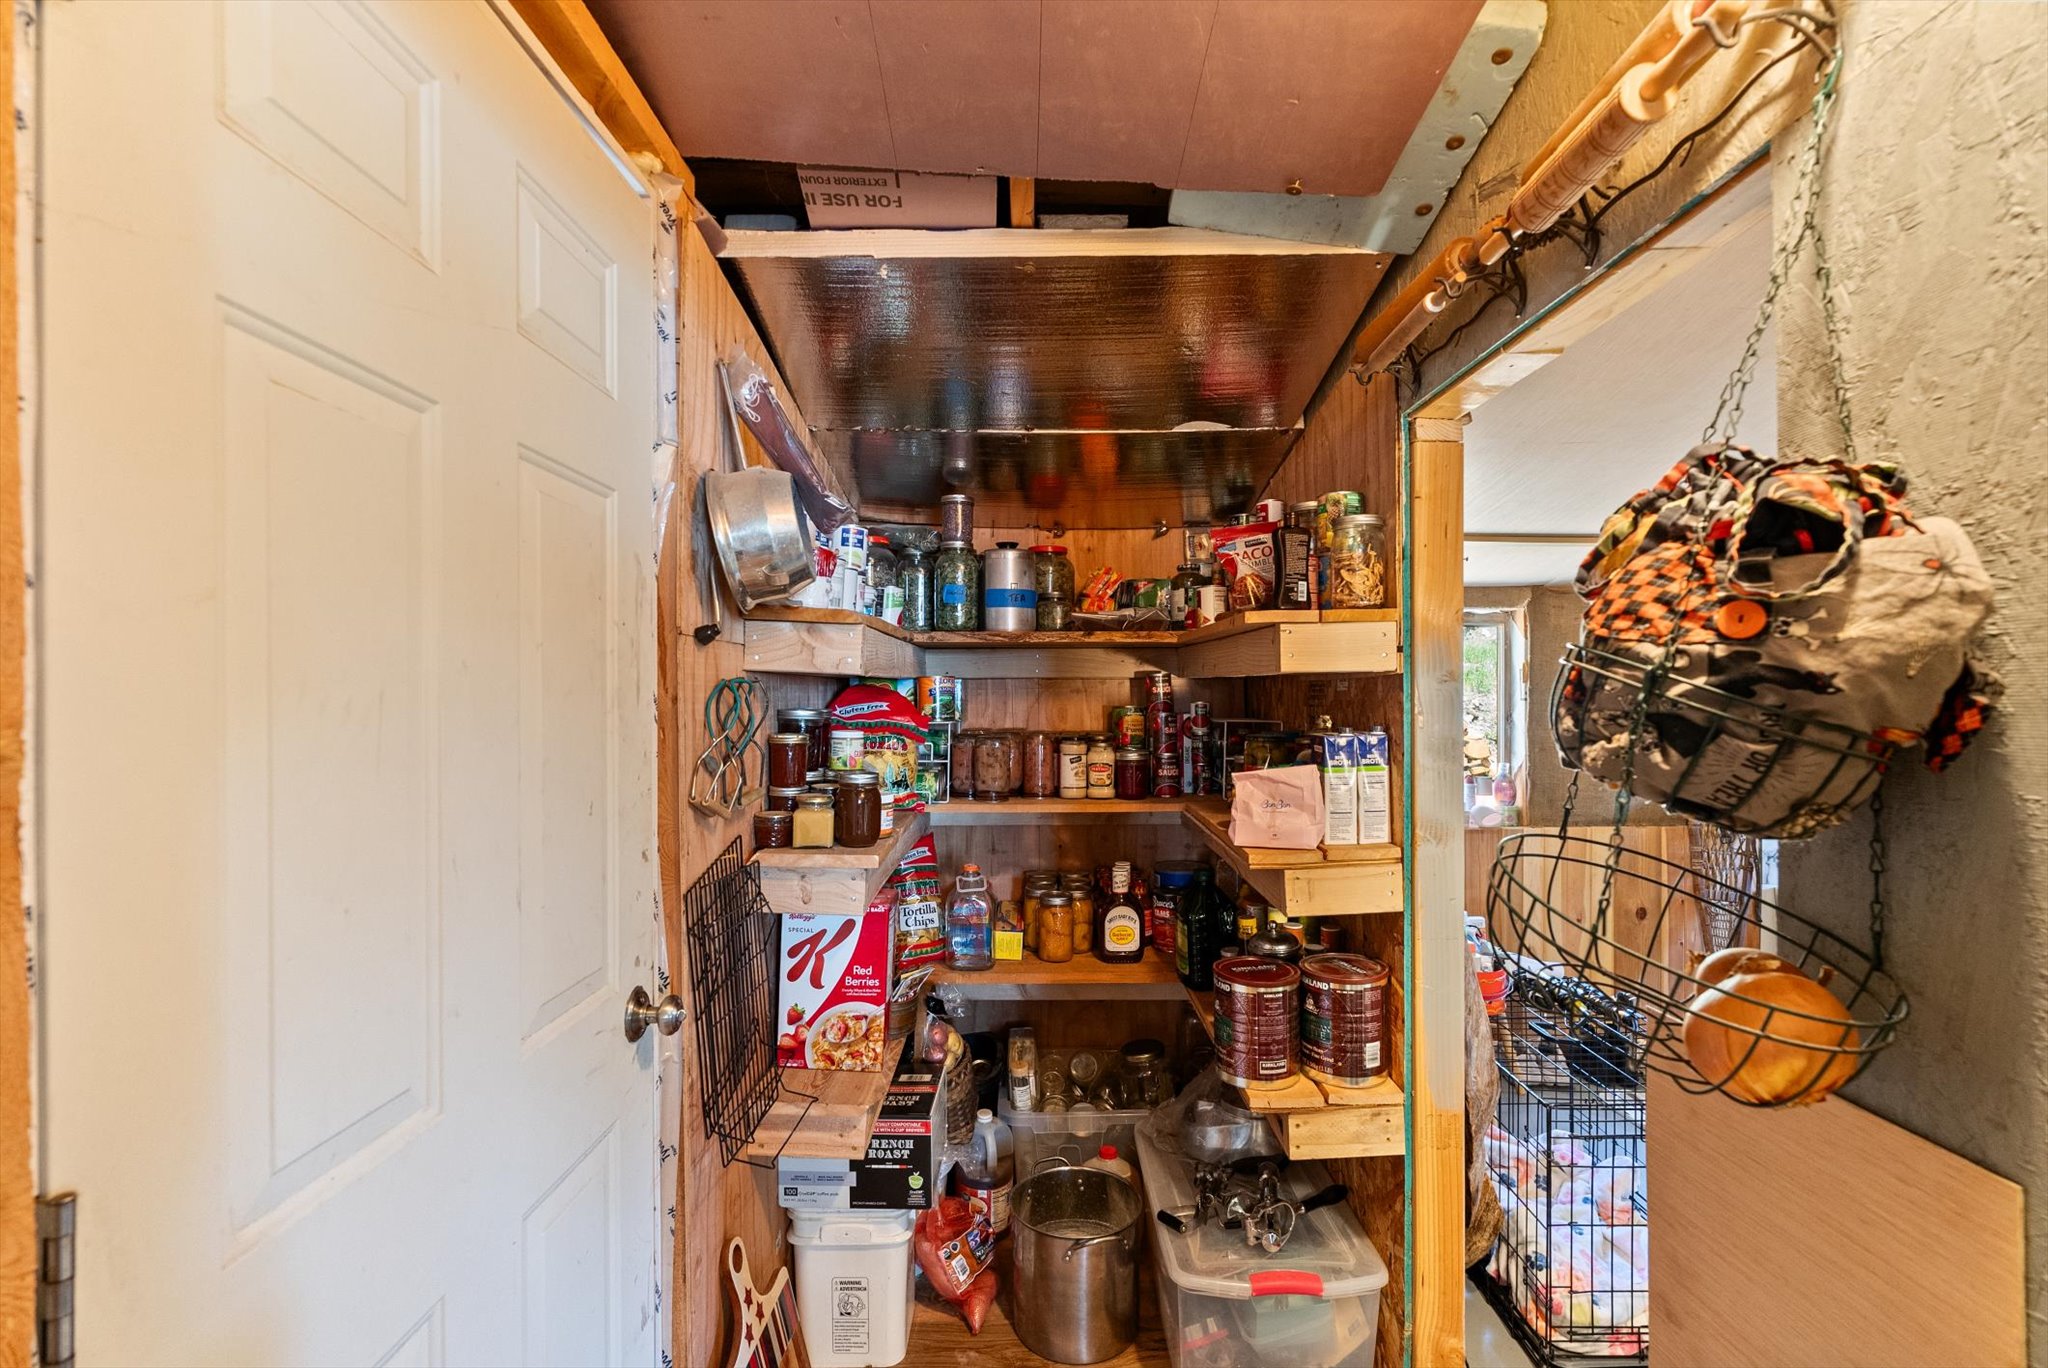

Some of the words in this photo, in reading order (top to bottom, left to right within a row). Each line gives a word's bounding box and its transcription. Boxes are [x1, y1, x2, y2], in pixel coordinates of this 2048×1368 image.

[832, 177, 888, 188] EXTERIOR
[822, 192, 860, 208] USE
[865, 195, 903, 209] FOR
[659, 200, 677, 230] Tyvek
[1008, 593, 1026, 603] TEA
[838, 706, 865, 716] Gluten
[866, 703, 884, 711] Free
[901, 903, 937, 917] Tortilla
[905, 917, 935, 928] Chips
[786, 918, 857, 990] K
[853, 965, 872, 975] Red
[845, 976, 880, 987] Berries
[871, 1138, 914, 1149] RENCH
[867, 1149, 911, 1159] ROAST
[785, 1188, 797, 1196] 100
